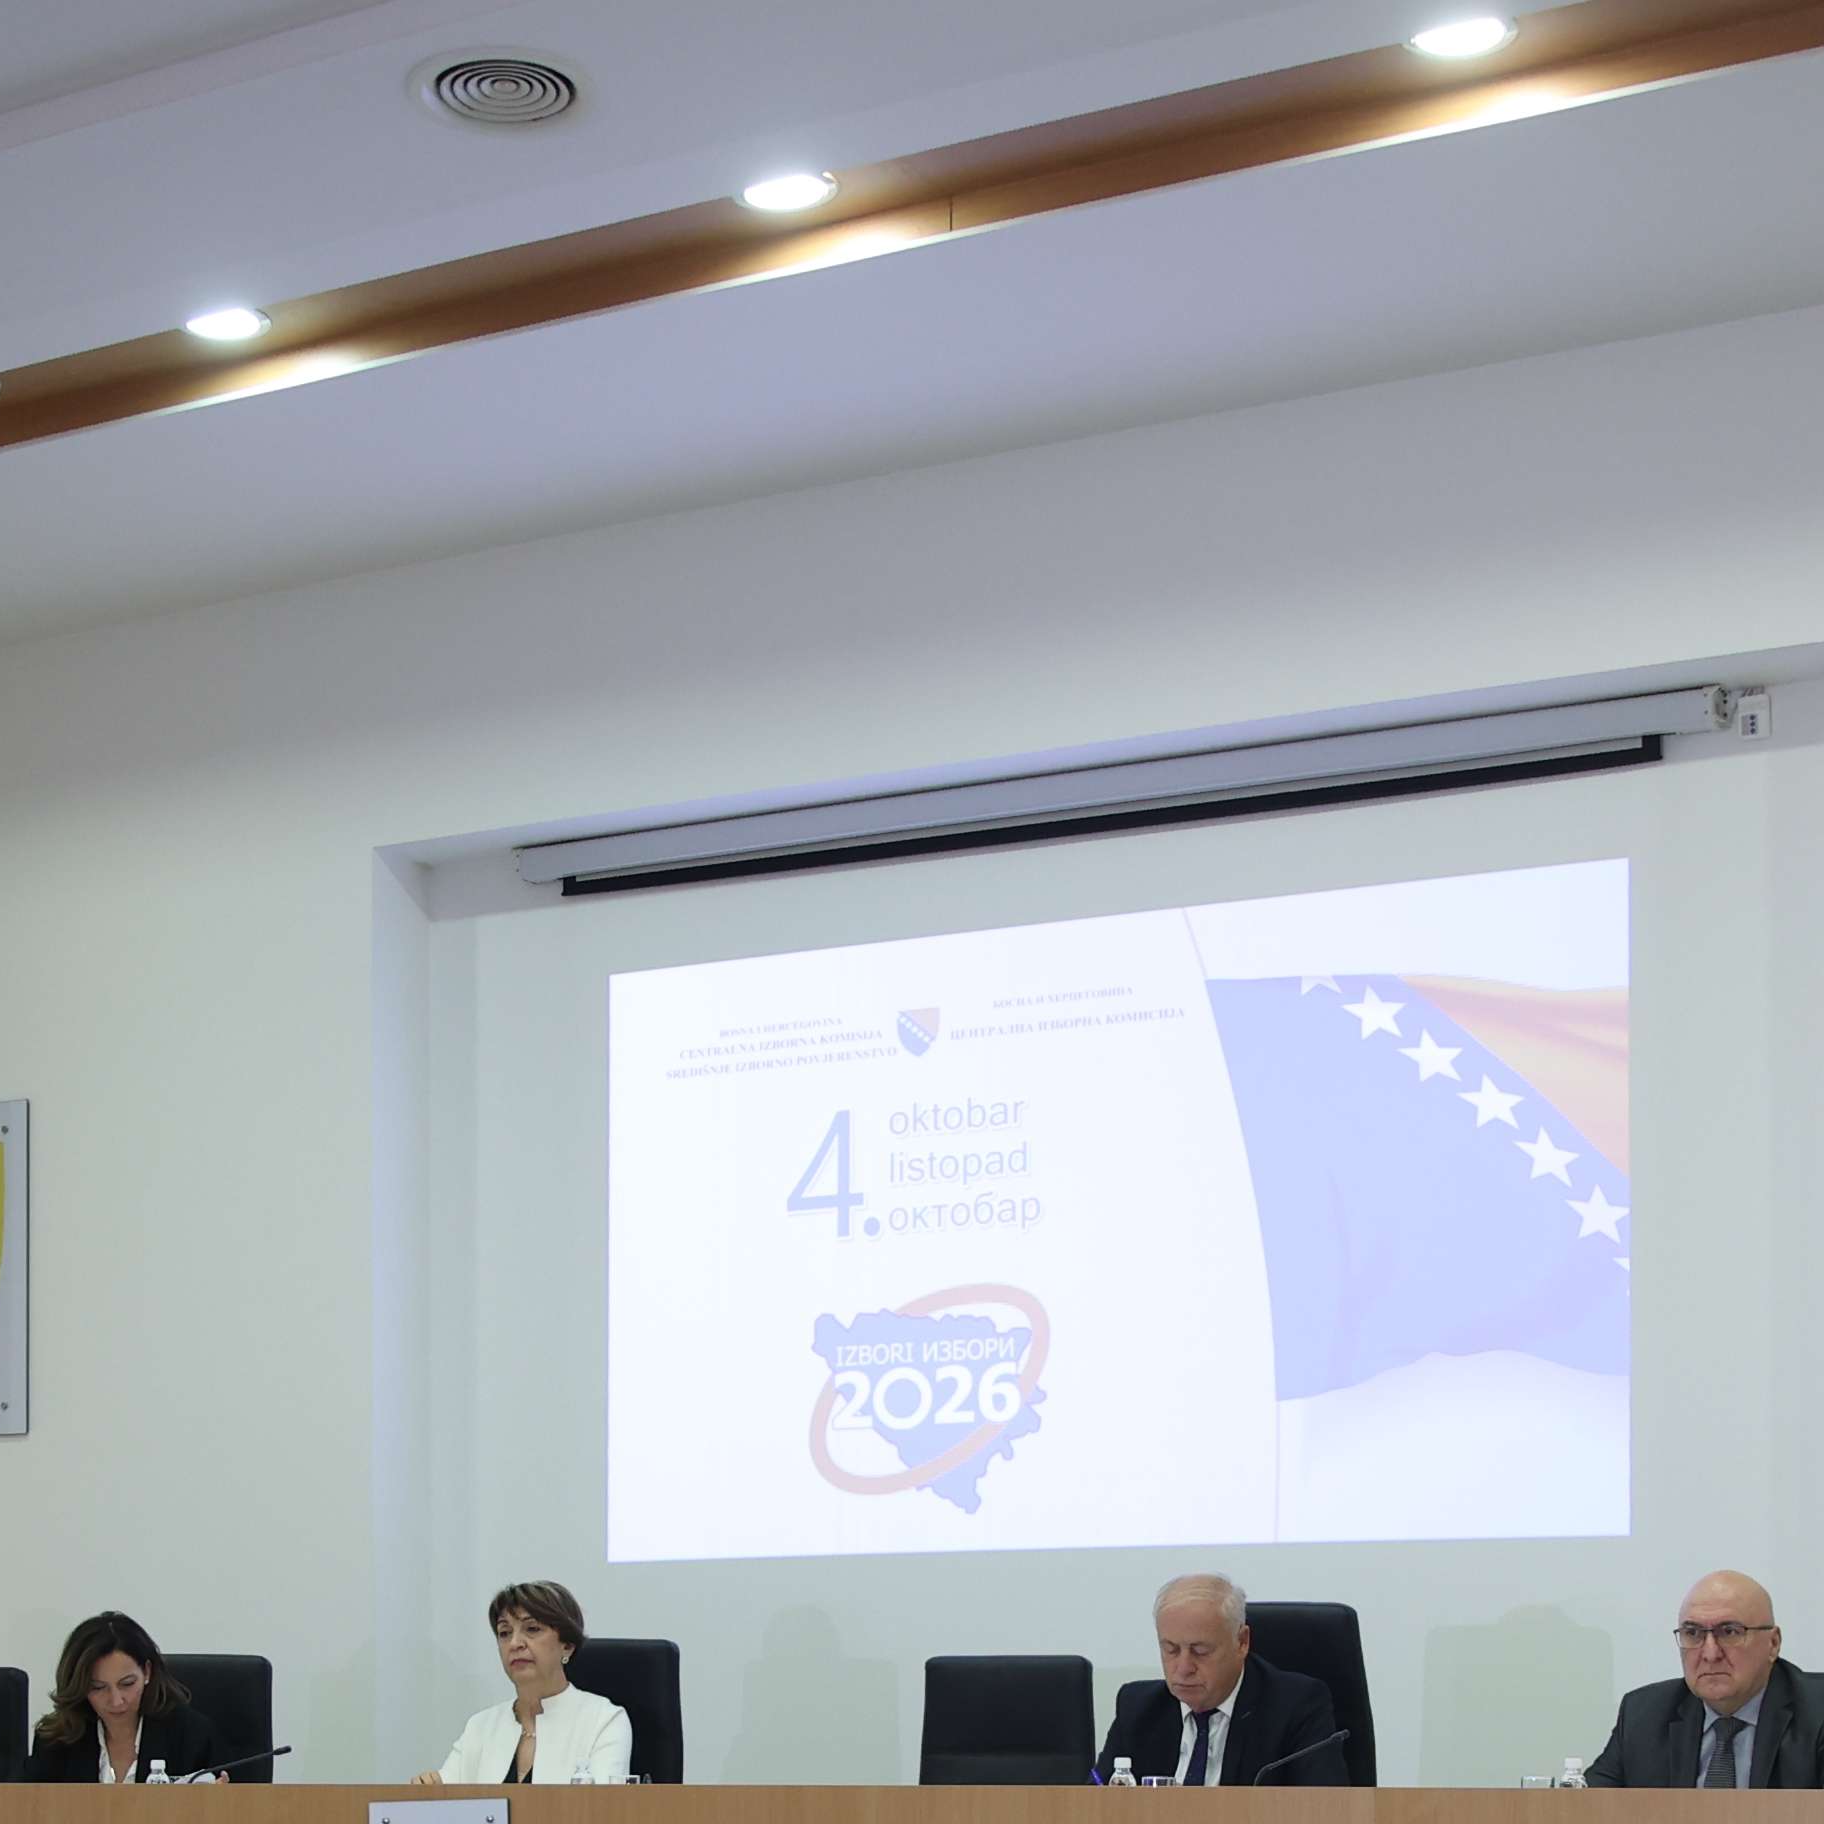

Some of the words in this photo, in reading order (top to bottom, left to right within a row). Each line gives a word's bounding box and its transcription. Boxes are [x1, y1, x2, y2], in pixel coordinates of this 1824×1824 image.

[679, 1040, 756, 1060] CENTRALNA
[759, 1036, 817, 1052] IZBORNA
[819, 1029, 883, 1046] KOMISIJA
[950, 1022, 1034, 1041] ЦЕНТРАЛНА
[1038, 1016, 1102, 1033] ИЗБОРНА
[735, 1055, 793, 1073] IZBORNO
[796, 1046, 898, 1066] POVJERENSTVO
[888, 1096, 1025, 1136] oktobar
[786, 1108, 881, 1237] 4.
[889, 1140, 1028, 1186] listopad
[888, 1191, 1041, 1232] октобар
[835, 1342, 914, 1368] IZBORI
[922, 1336, 1016, 1363] ИЗБОРИ
[831, 1361, 1022, 1431] 2026
